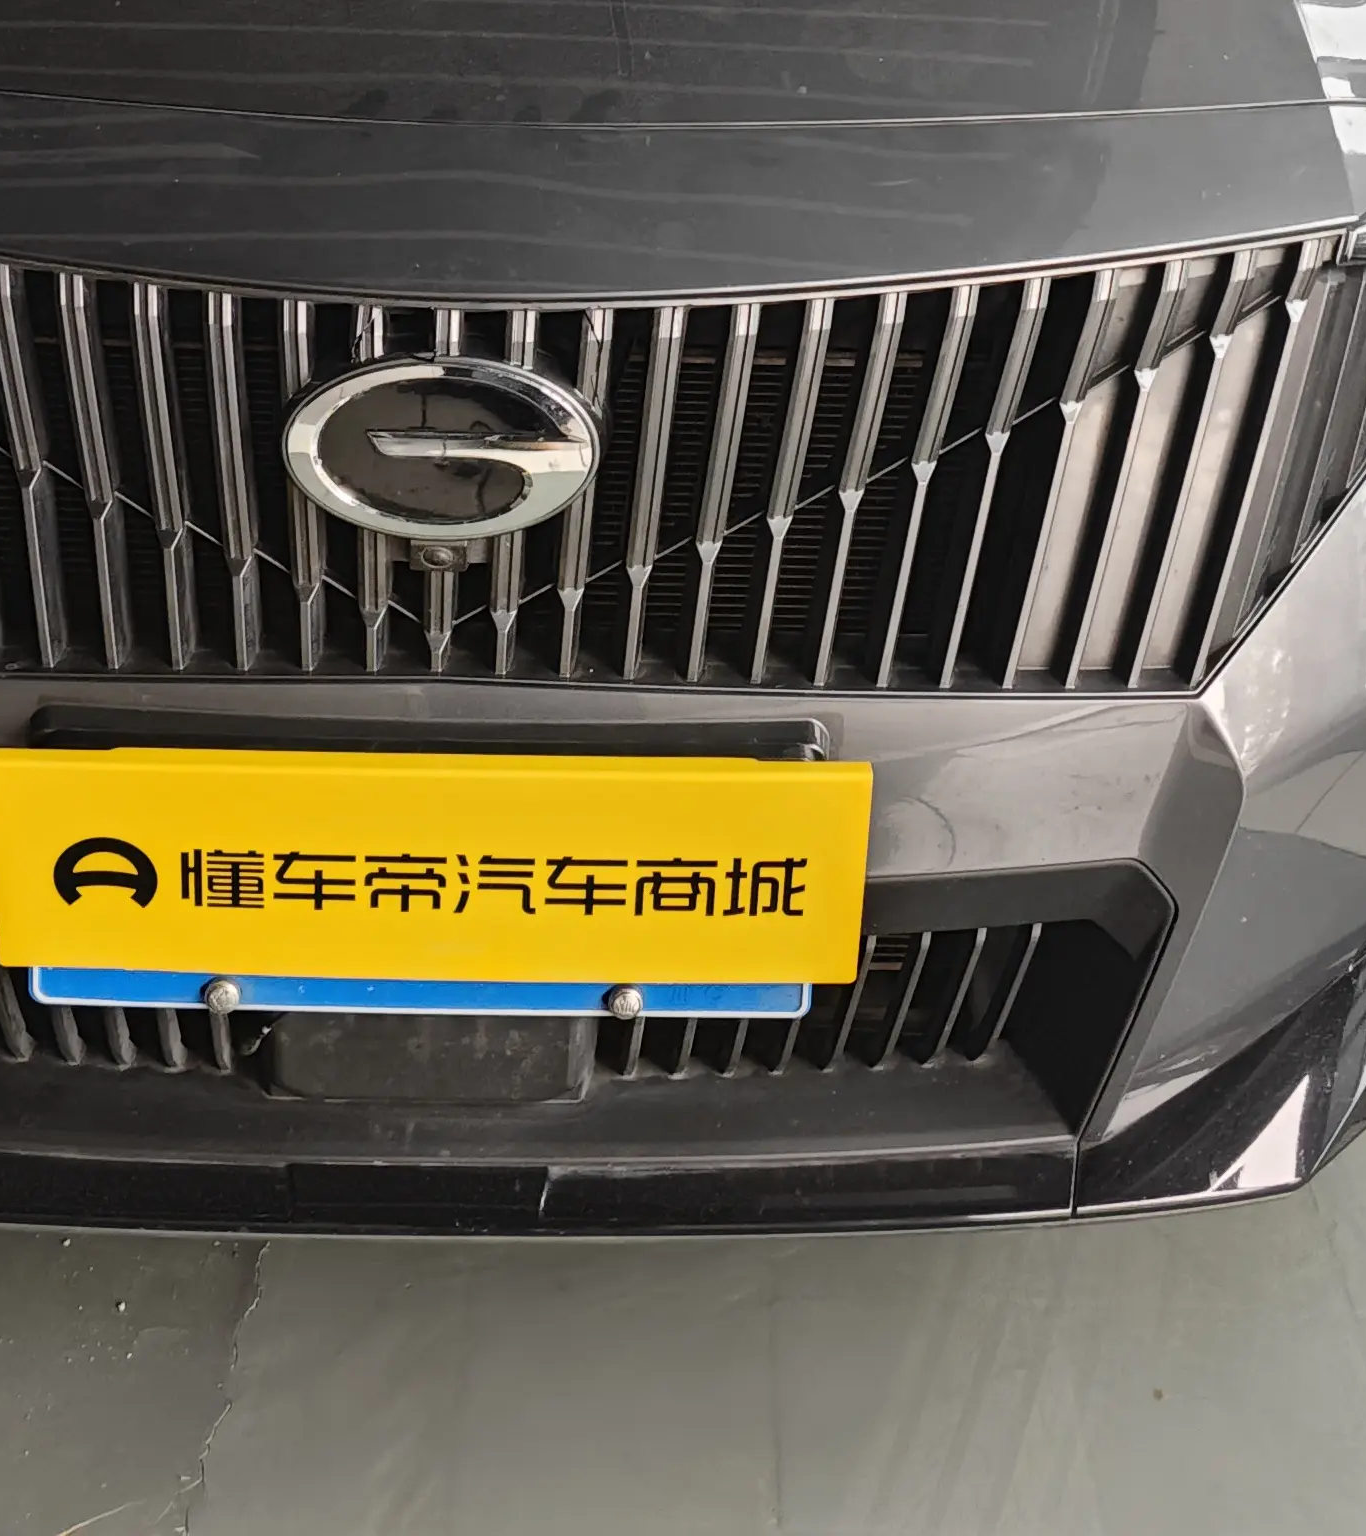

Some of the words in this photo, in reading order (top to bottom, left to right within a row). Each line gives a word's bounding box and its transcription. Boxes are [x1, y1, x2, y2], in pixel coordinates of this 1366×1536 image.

[180, 848, 807, 916] 懂车帝汽车商城
